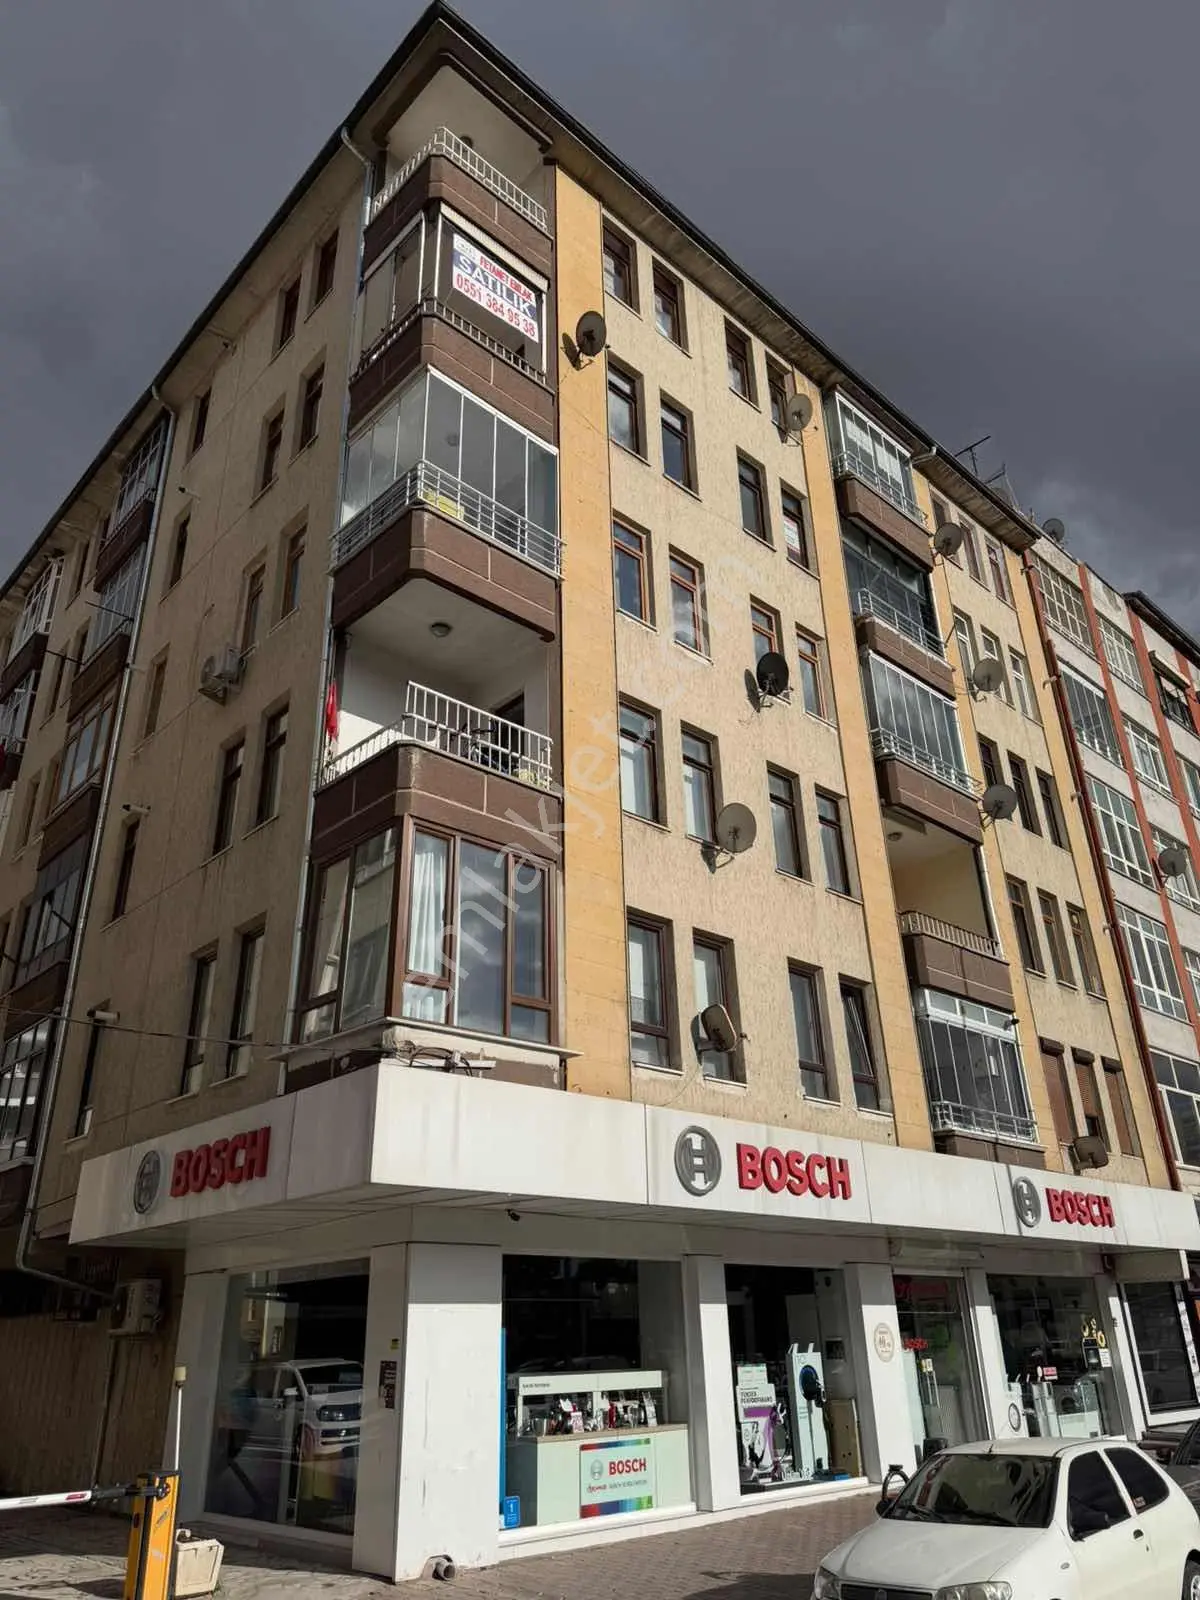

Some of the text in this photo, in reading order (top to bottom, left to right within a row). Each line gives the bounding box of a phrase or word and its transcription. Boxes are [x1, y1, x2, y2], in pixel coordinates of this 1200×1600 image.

[456, 273, 482, 301] 0551
[523, 318, 536, 336] 38
[460, 256, 533, 318] SATILIK
[170, 1126, 271, 1198] BOSCH
[736, 1143, 852, 1200] BOSCH
[1045, 1187, 1115, 1228] BOSCH
[608, 1457, 647, 1476] BOSCH
